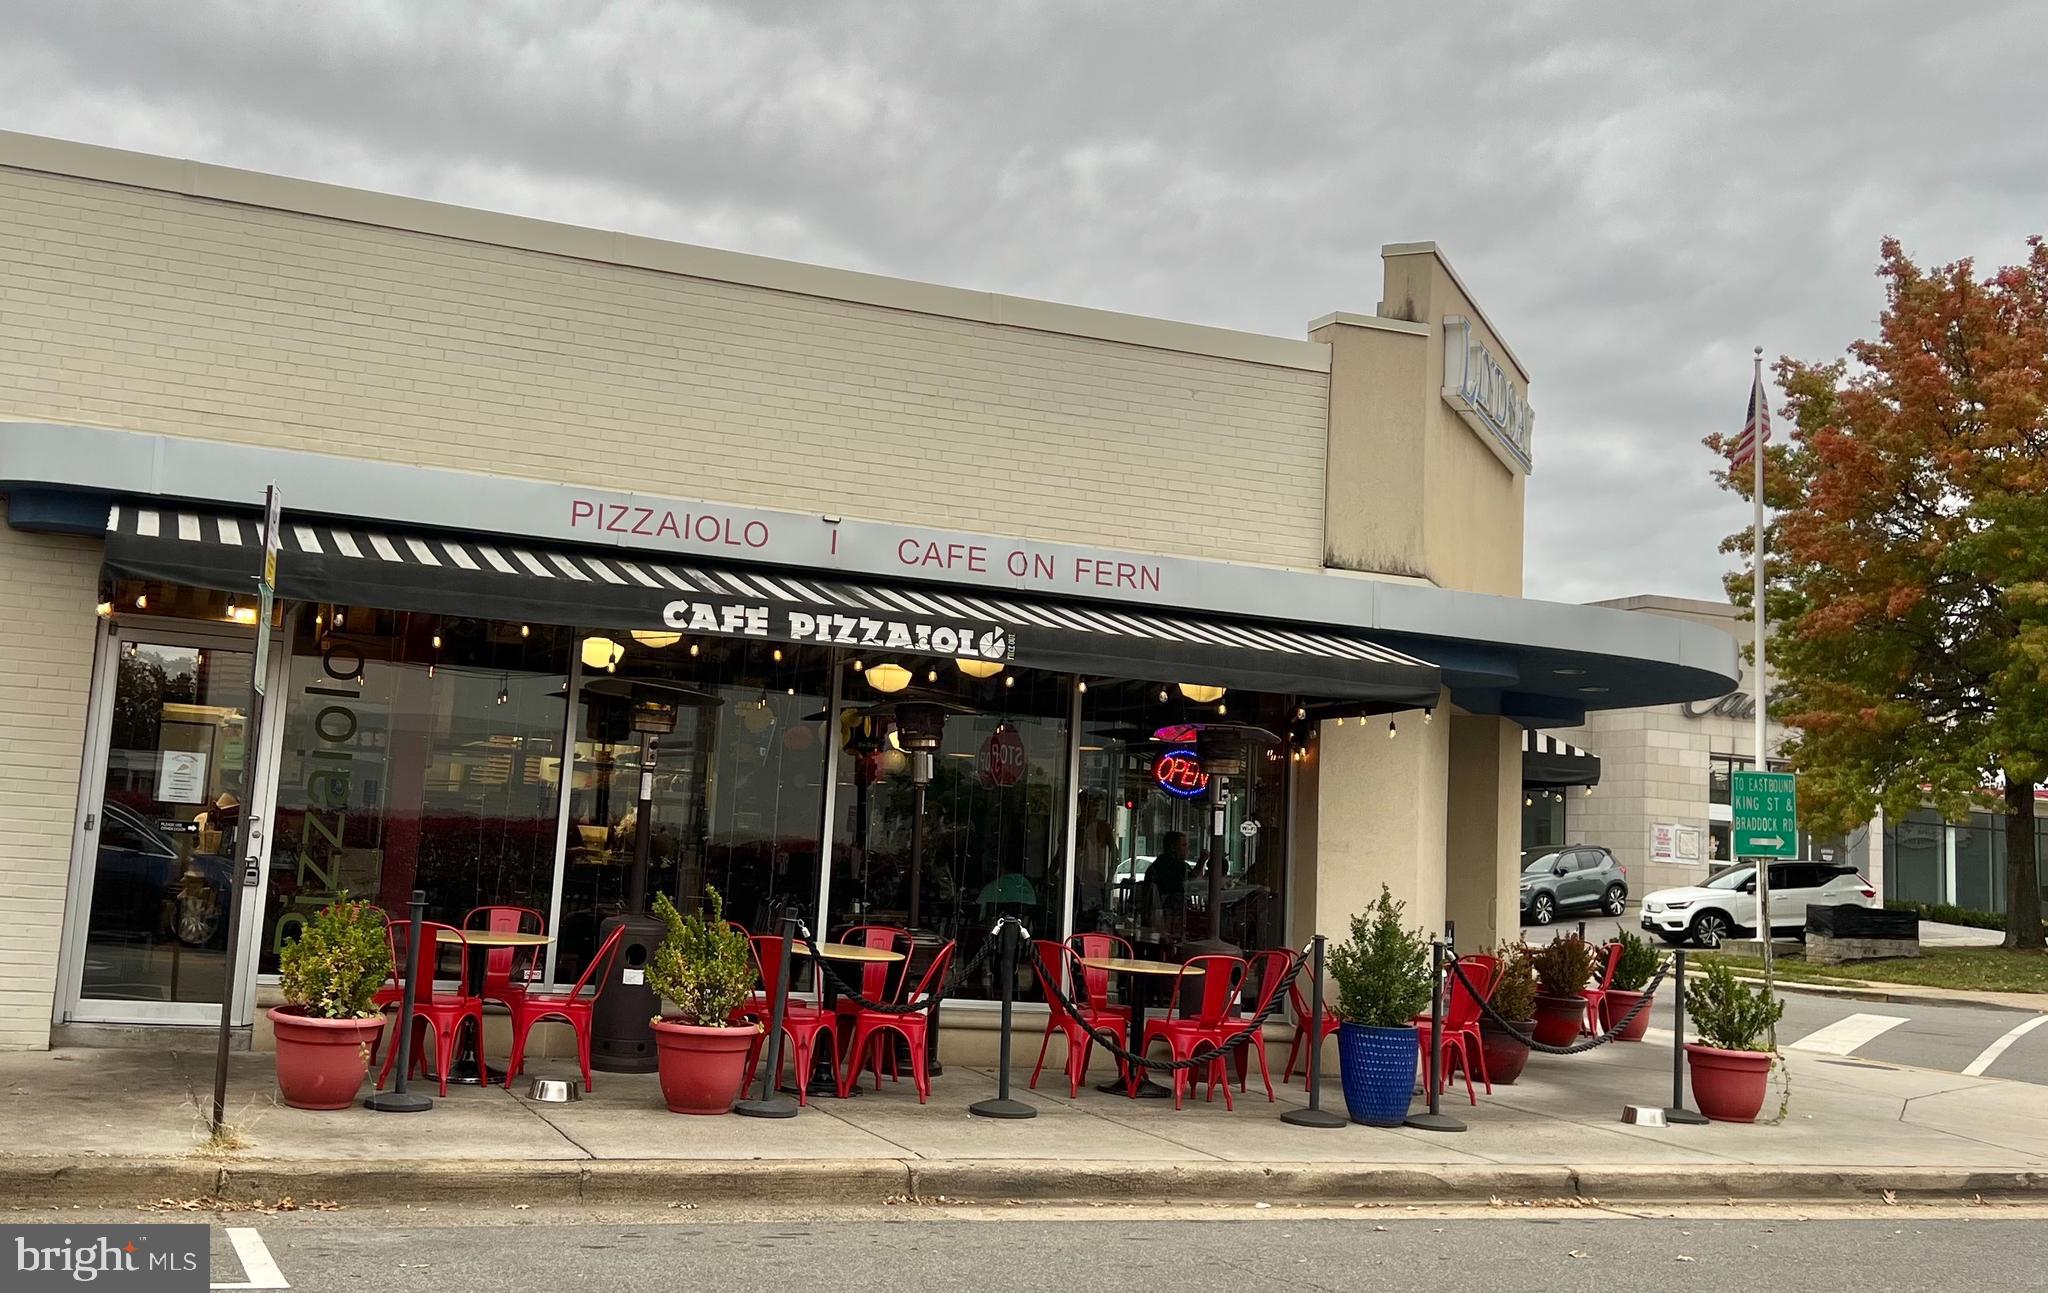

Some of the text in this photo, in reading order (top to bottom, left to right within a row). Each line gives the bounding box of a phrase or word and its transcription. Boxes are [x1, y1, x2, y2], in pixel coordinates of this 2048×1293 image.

[571, 500, 769, 548] PIZZAIOLO
[898, 538, 987, 573] CAFE
[1007, 551, 1055, 580] ON
[1074, 557, 1160, 592] FERN
[1156, 756, 1210, 789] OPEN
[1734, 777, 1793, 793] TO EASTBOUND
[1735, 796, 1793, 812] KING ST &
[1735, 817, 1793, 832] BRADDOCK RD
